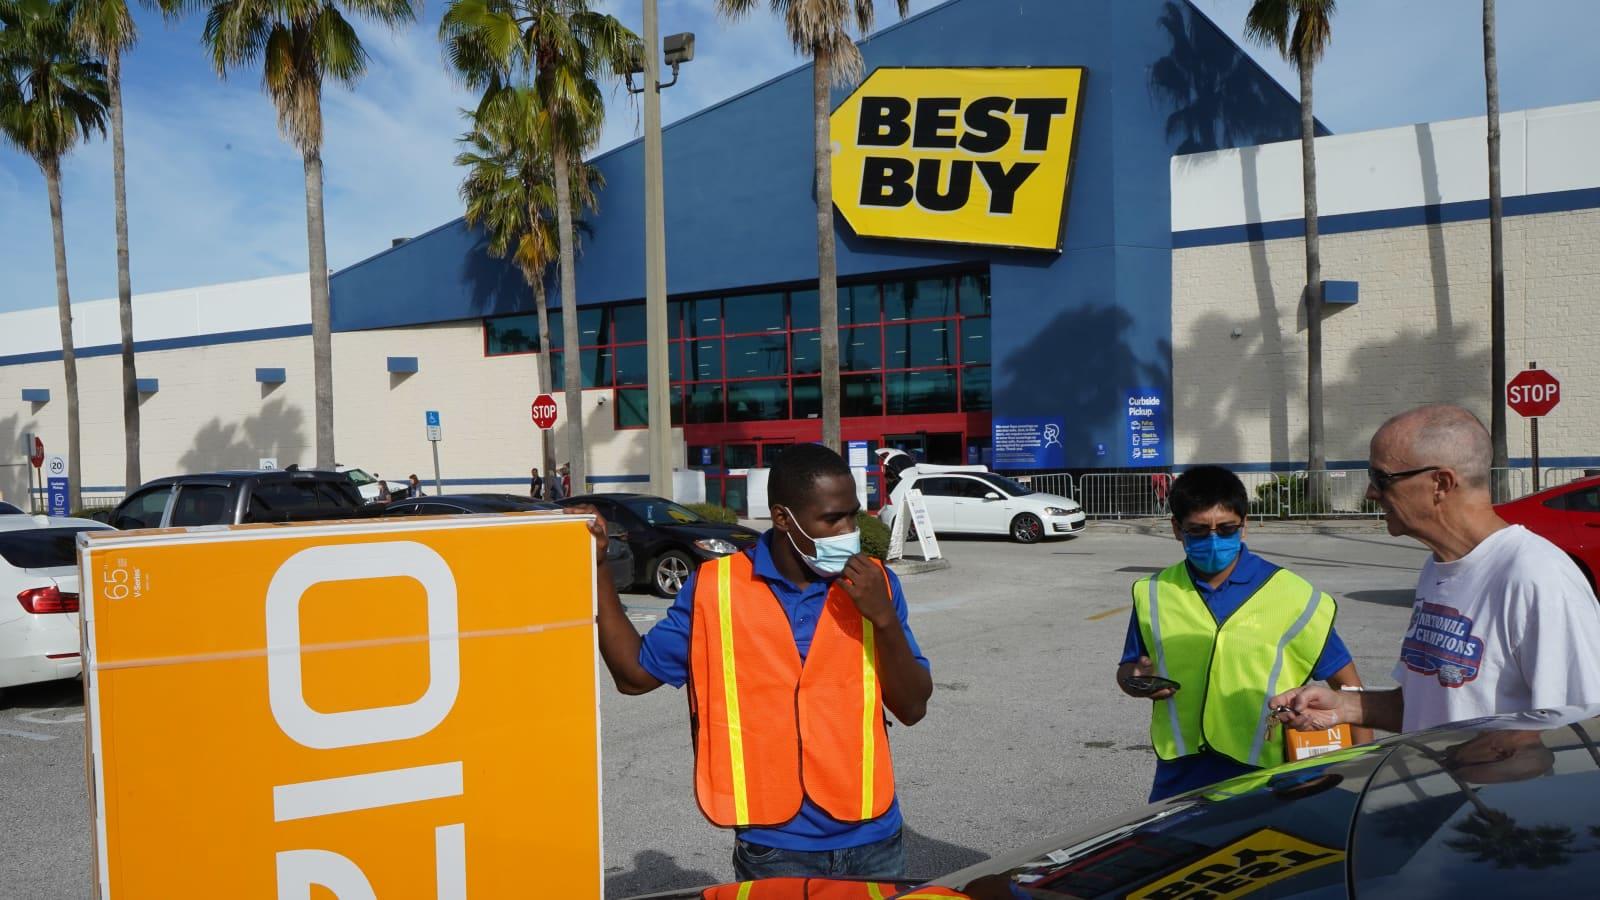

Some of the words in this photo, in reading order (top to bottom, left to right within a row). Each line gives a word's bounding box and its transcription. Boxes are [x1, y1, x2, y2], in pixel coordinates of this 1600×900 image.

[857, 96, 1068, 153] BEST
[859, 156, 1041, 214] BUY
[1509, 383, 1557, 404] STOP
[1128, 396, 1160, 406] Curbside
[532, 405, 556, 419] STOP
[1128, 407, 1155, 417] Pickup.
[52, 462, 63, 470] 20
